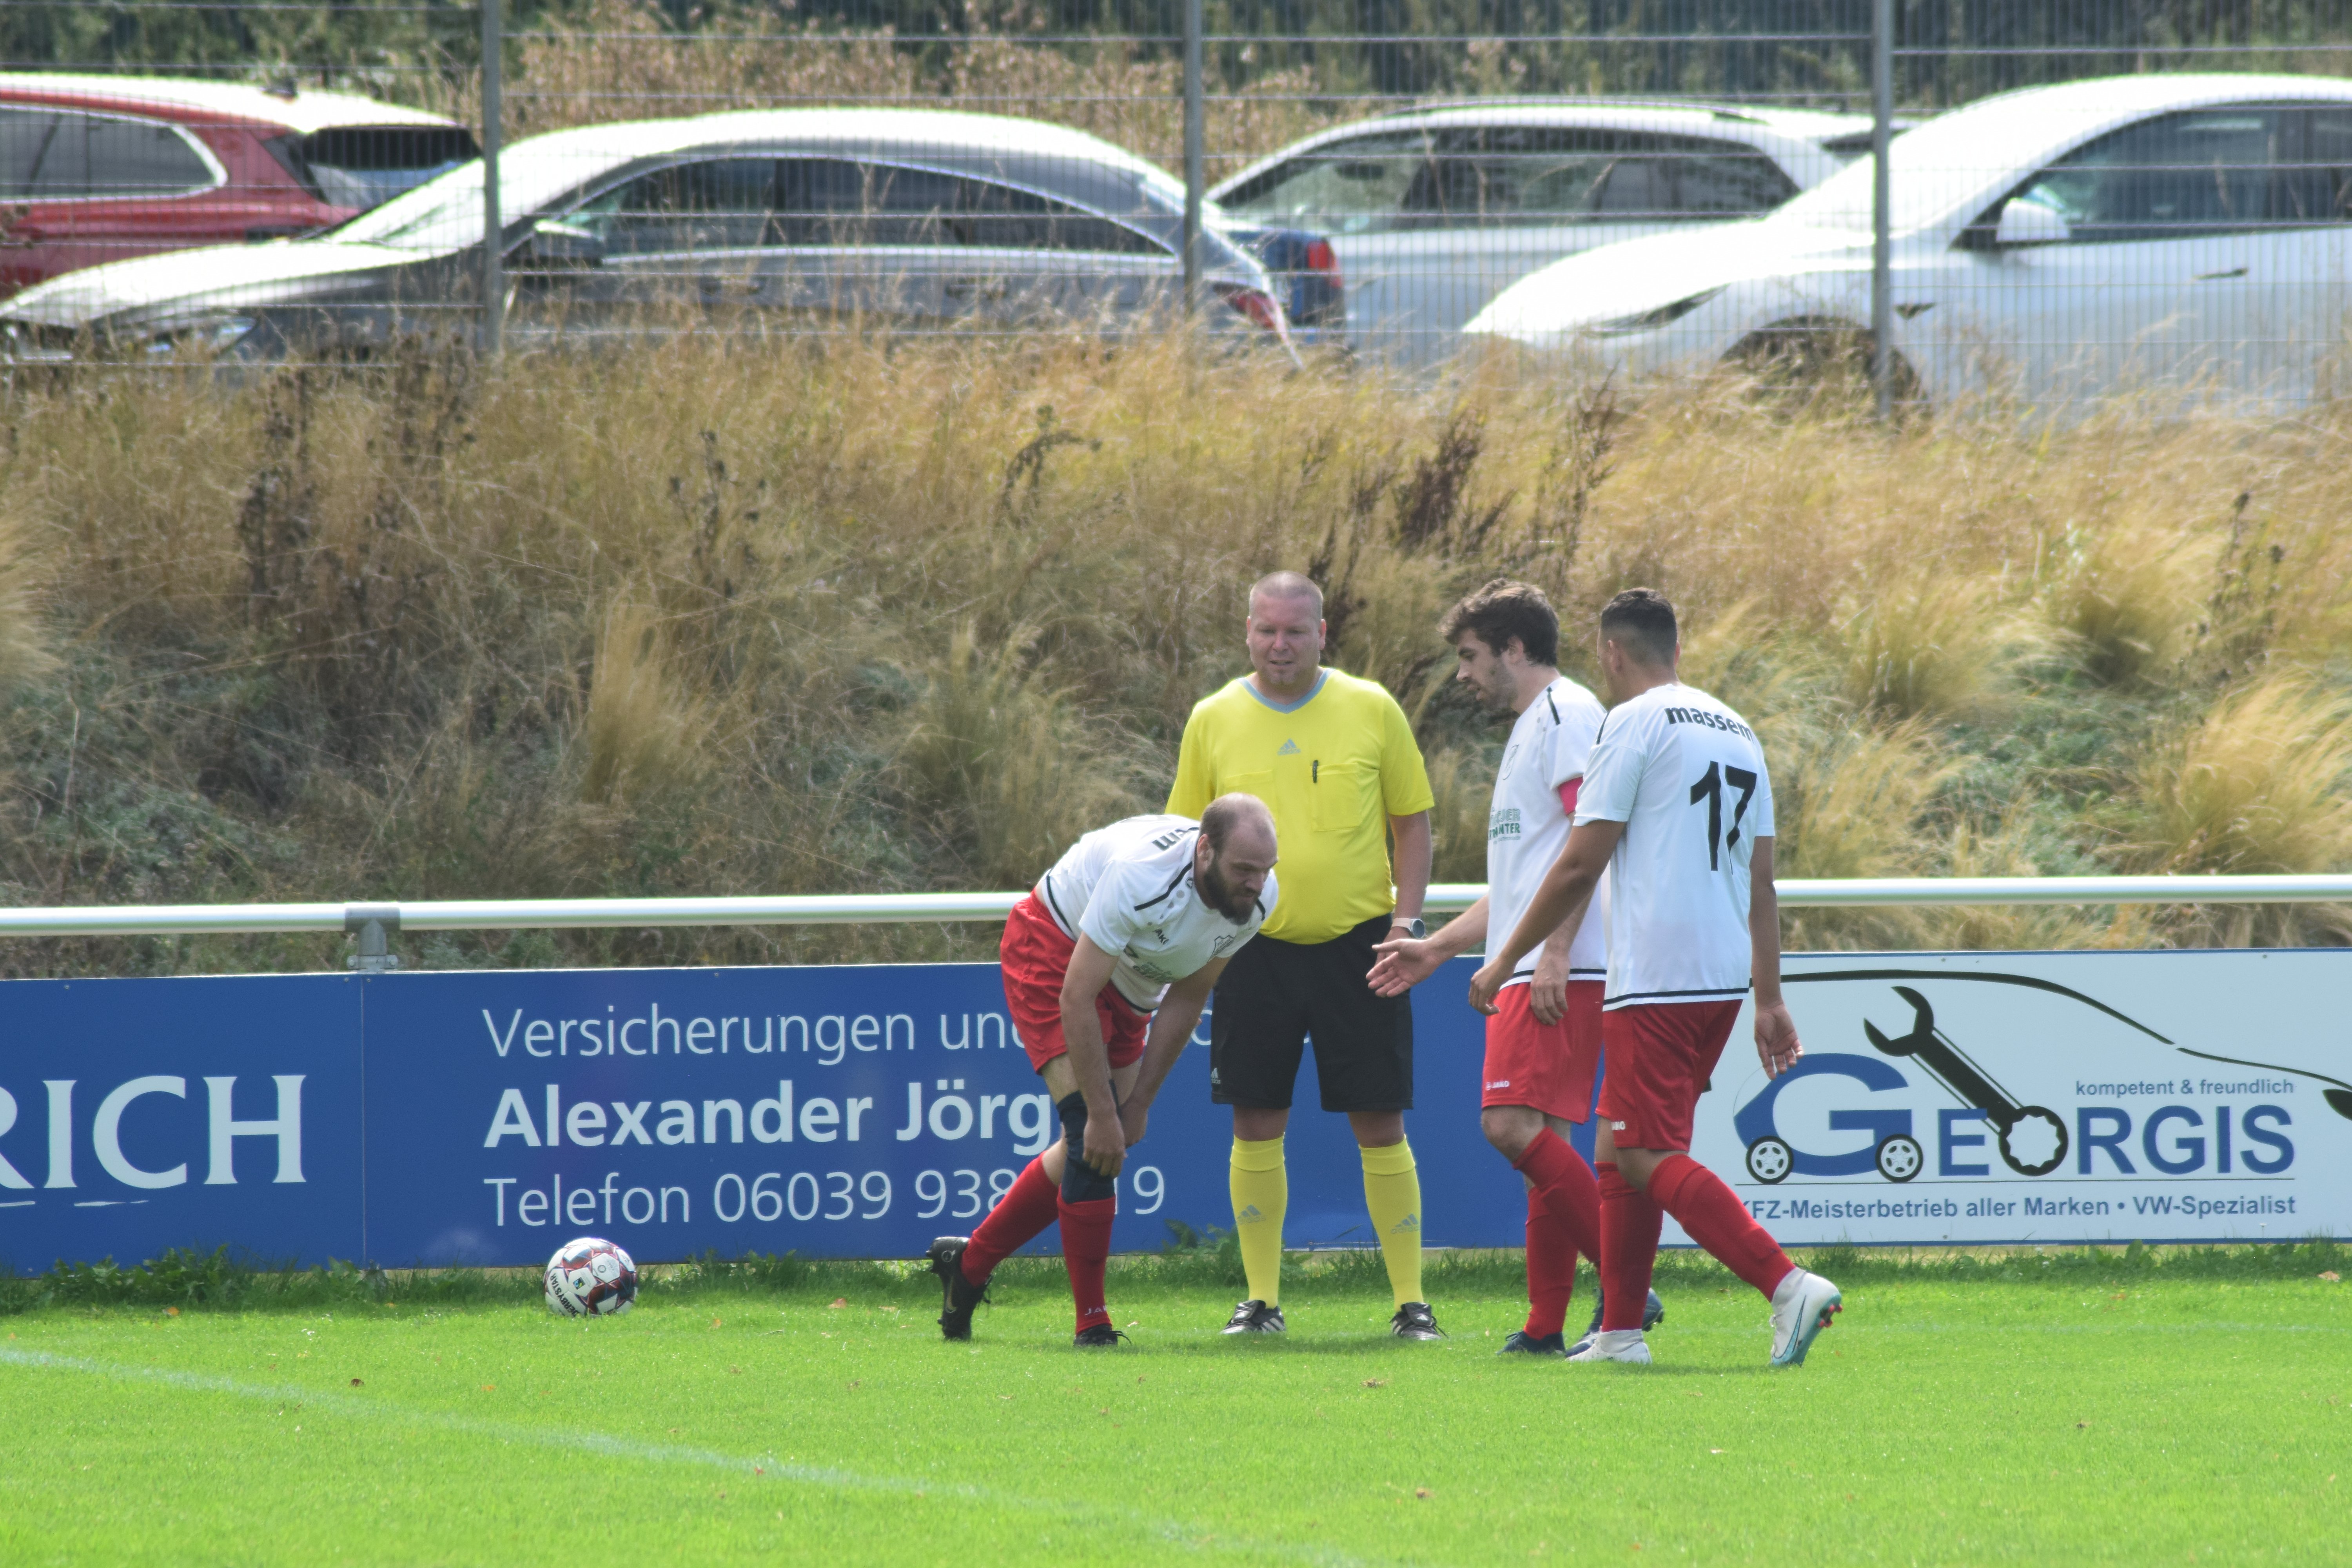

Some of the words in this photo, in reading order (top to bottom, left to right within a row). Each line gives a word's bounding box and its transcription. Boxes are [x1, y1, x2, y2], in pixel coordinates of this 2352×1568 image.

[1690, 760, 1757, 875] 17
[482, 1003, 915, 1065] Versicherungen
[483, 1080, 873, 1148] Alexander
[896, 1078, 1051, 1156] Jörg
[2075, 1080, 2174, 1099] kompetent
[2181, 1079, 2194, 1094] &
[2199, 1078, 2294, 1094] freundlich
[483, 1172, 690, 1226] Telefon
[714, 1171, 892, 1222] 06039
[1965, 1197, 2016, 1217] aller
[2024, 1196, 2109, 1216] Marken
[2132, 1195, 2296, 1220] VW-Spezialist
